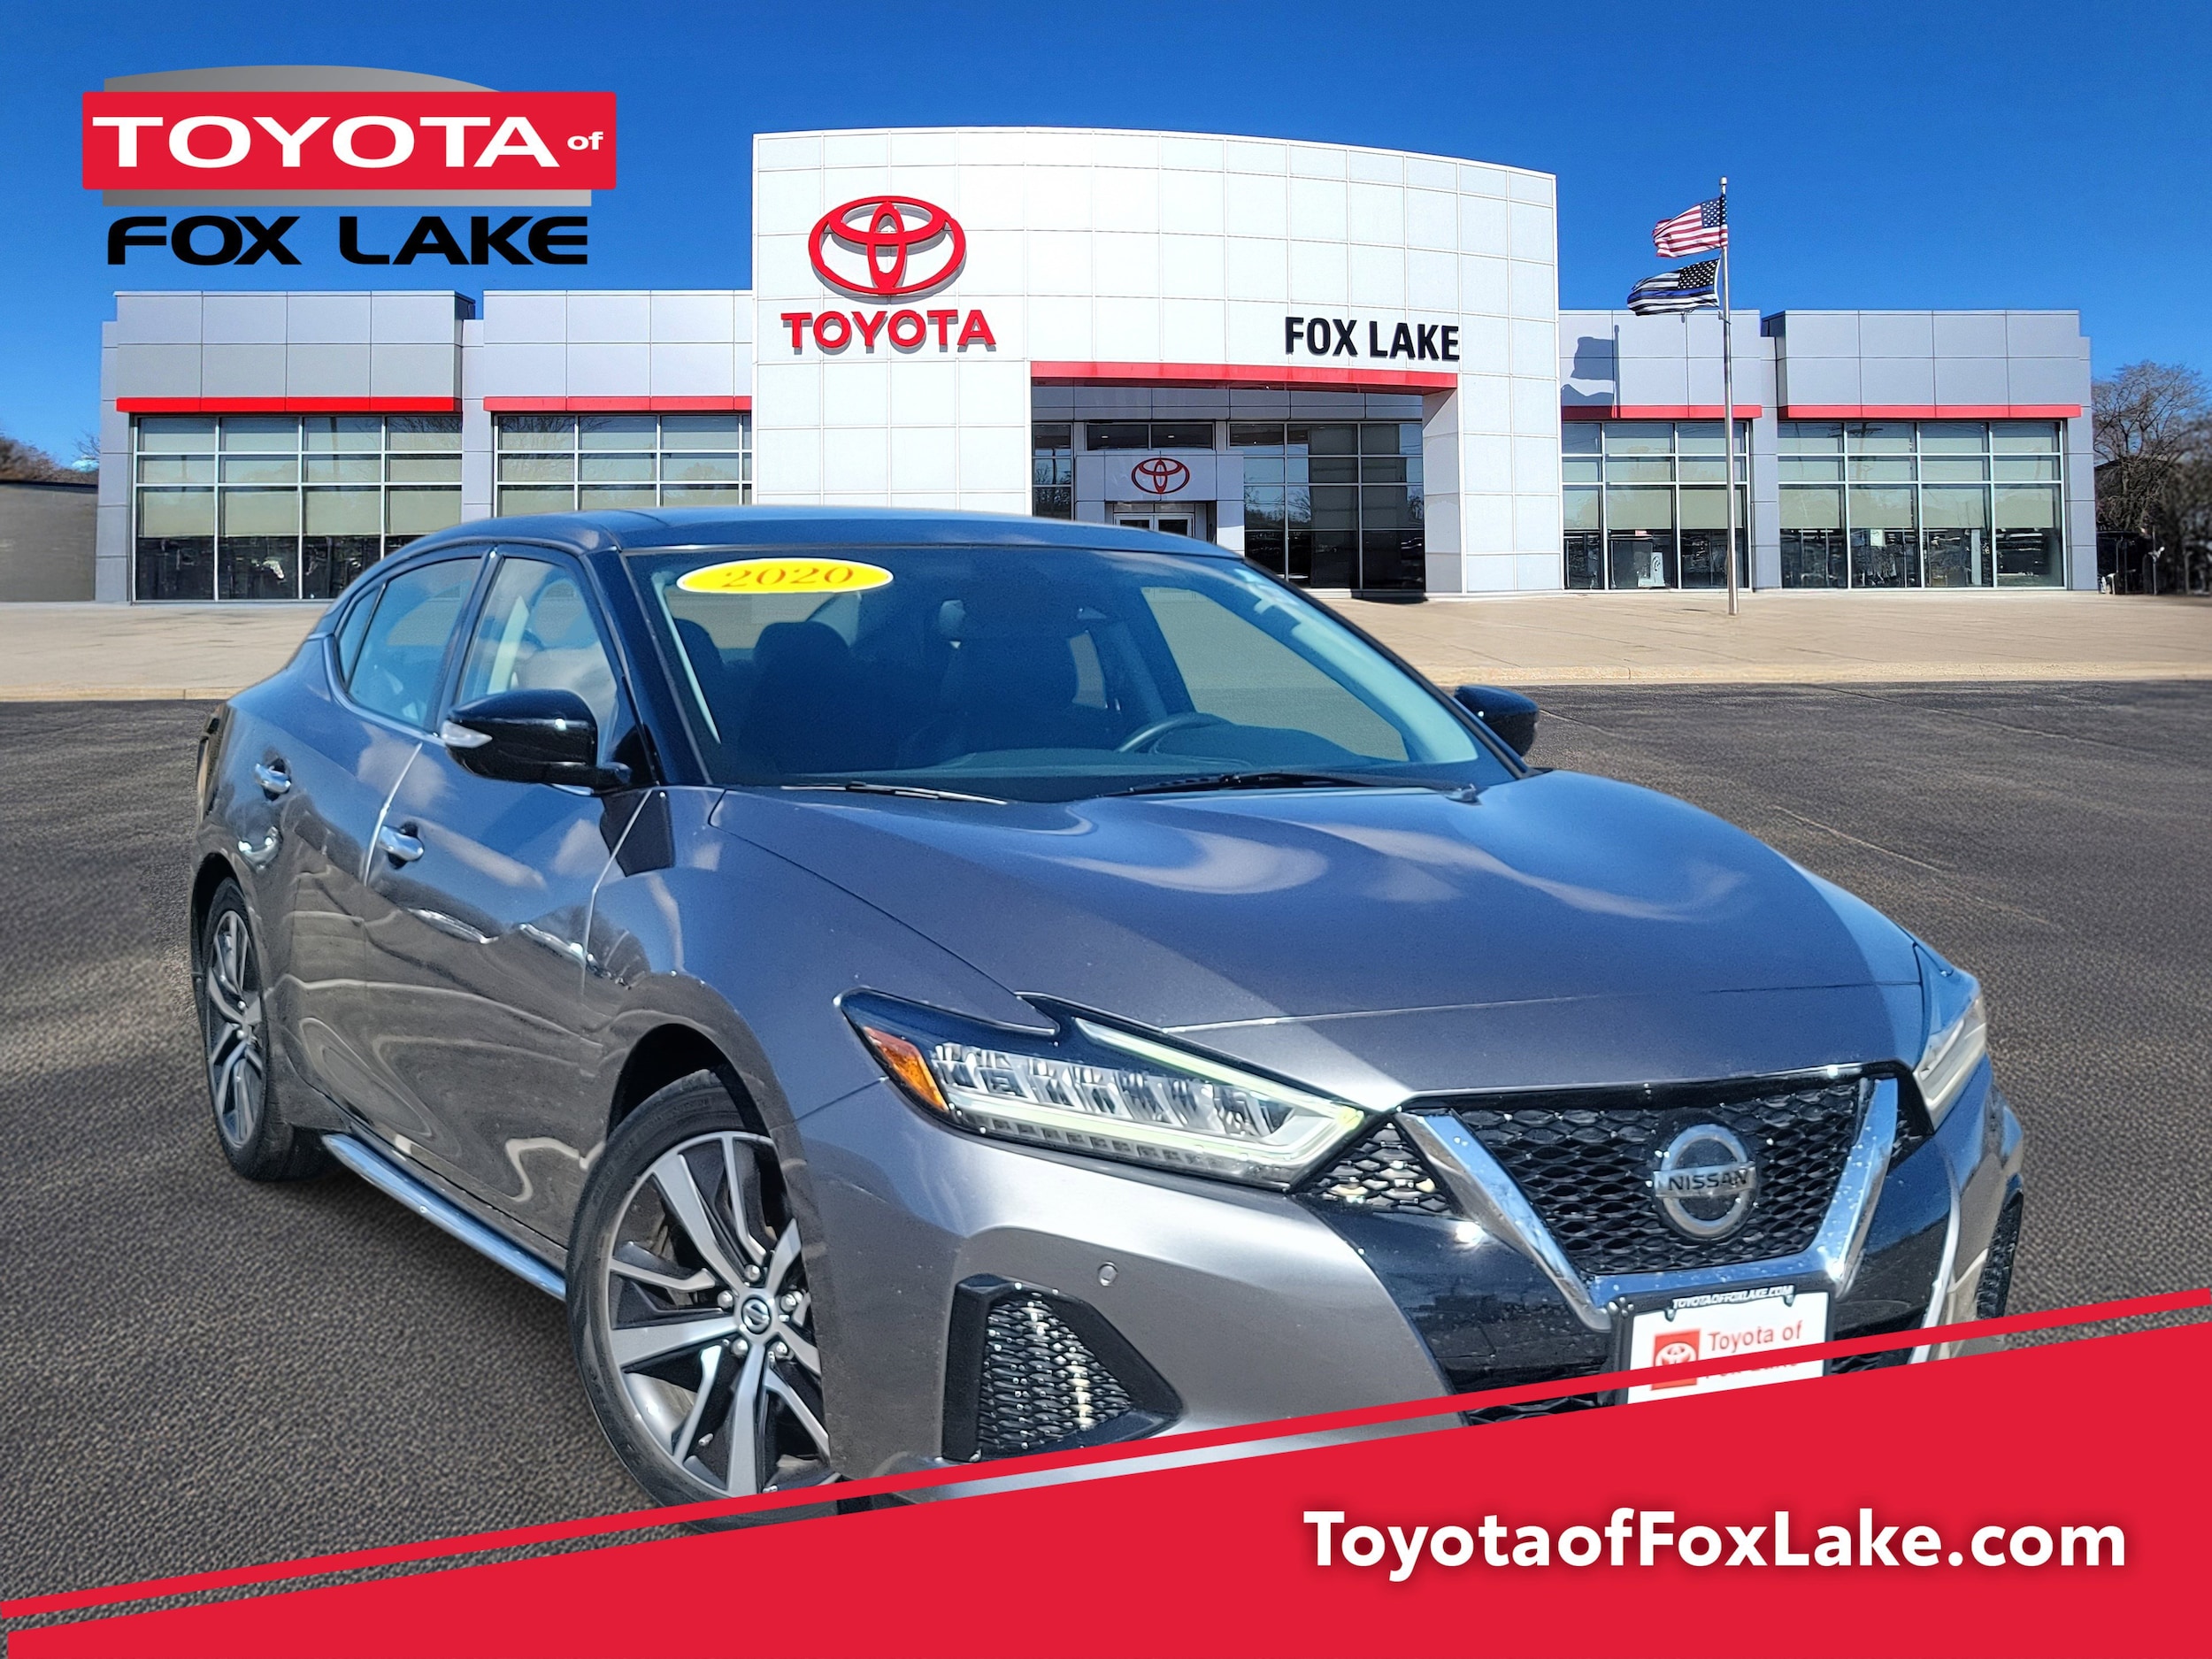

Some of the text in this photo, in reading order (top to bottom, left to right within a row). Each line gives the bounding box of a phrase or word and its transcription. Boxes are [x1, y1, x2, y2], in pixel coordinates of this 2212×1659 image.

[780, 309, 997, 350] TOYOTA
[1285, 316, 1460, 361] FOX LAKE
[721, 566, 854, 588] 2020
[1668, 1169, 1748, 1191] NISSAN
[1708, 1319, 1803, 1354] Toyota of
